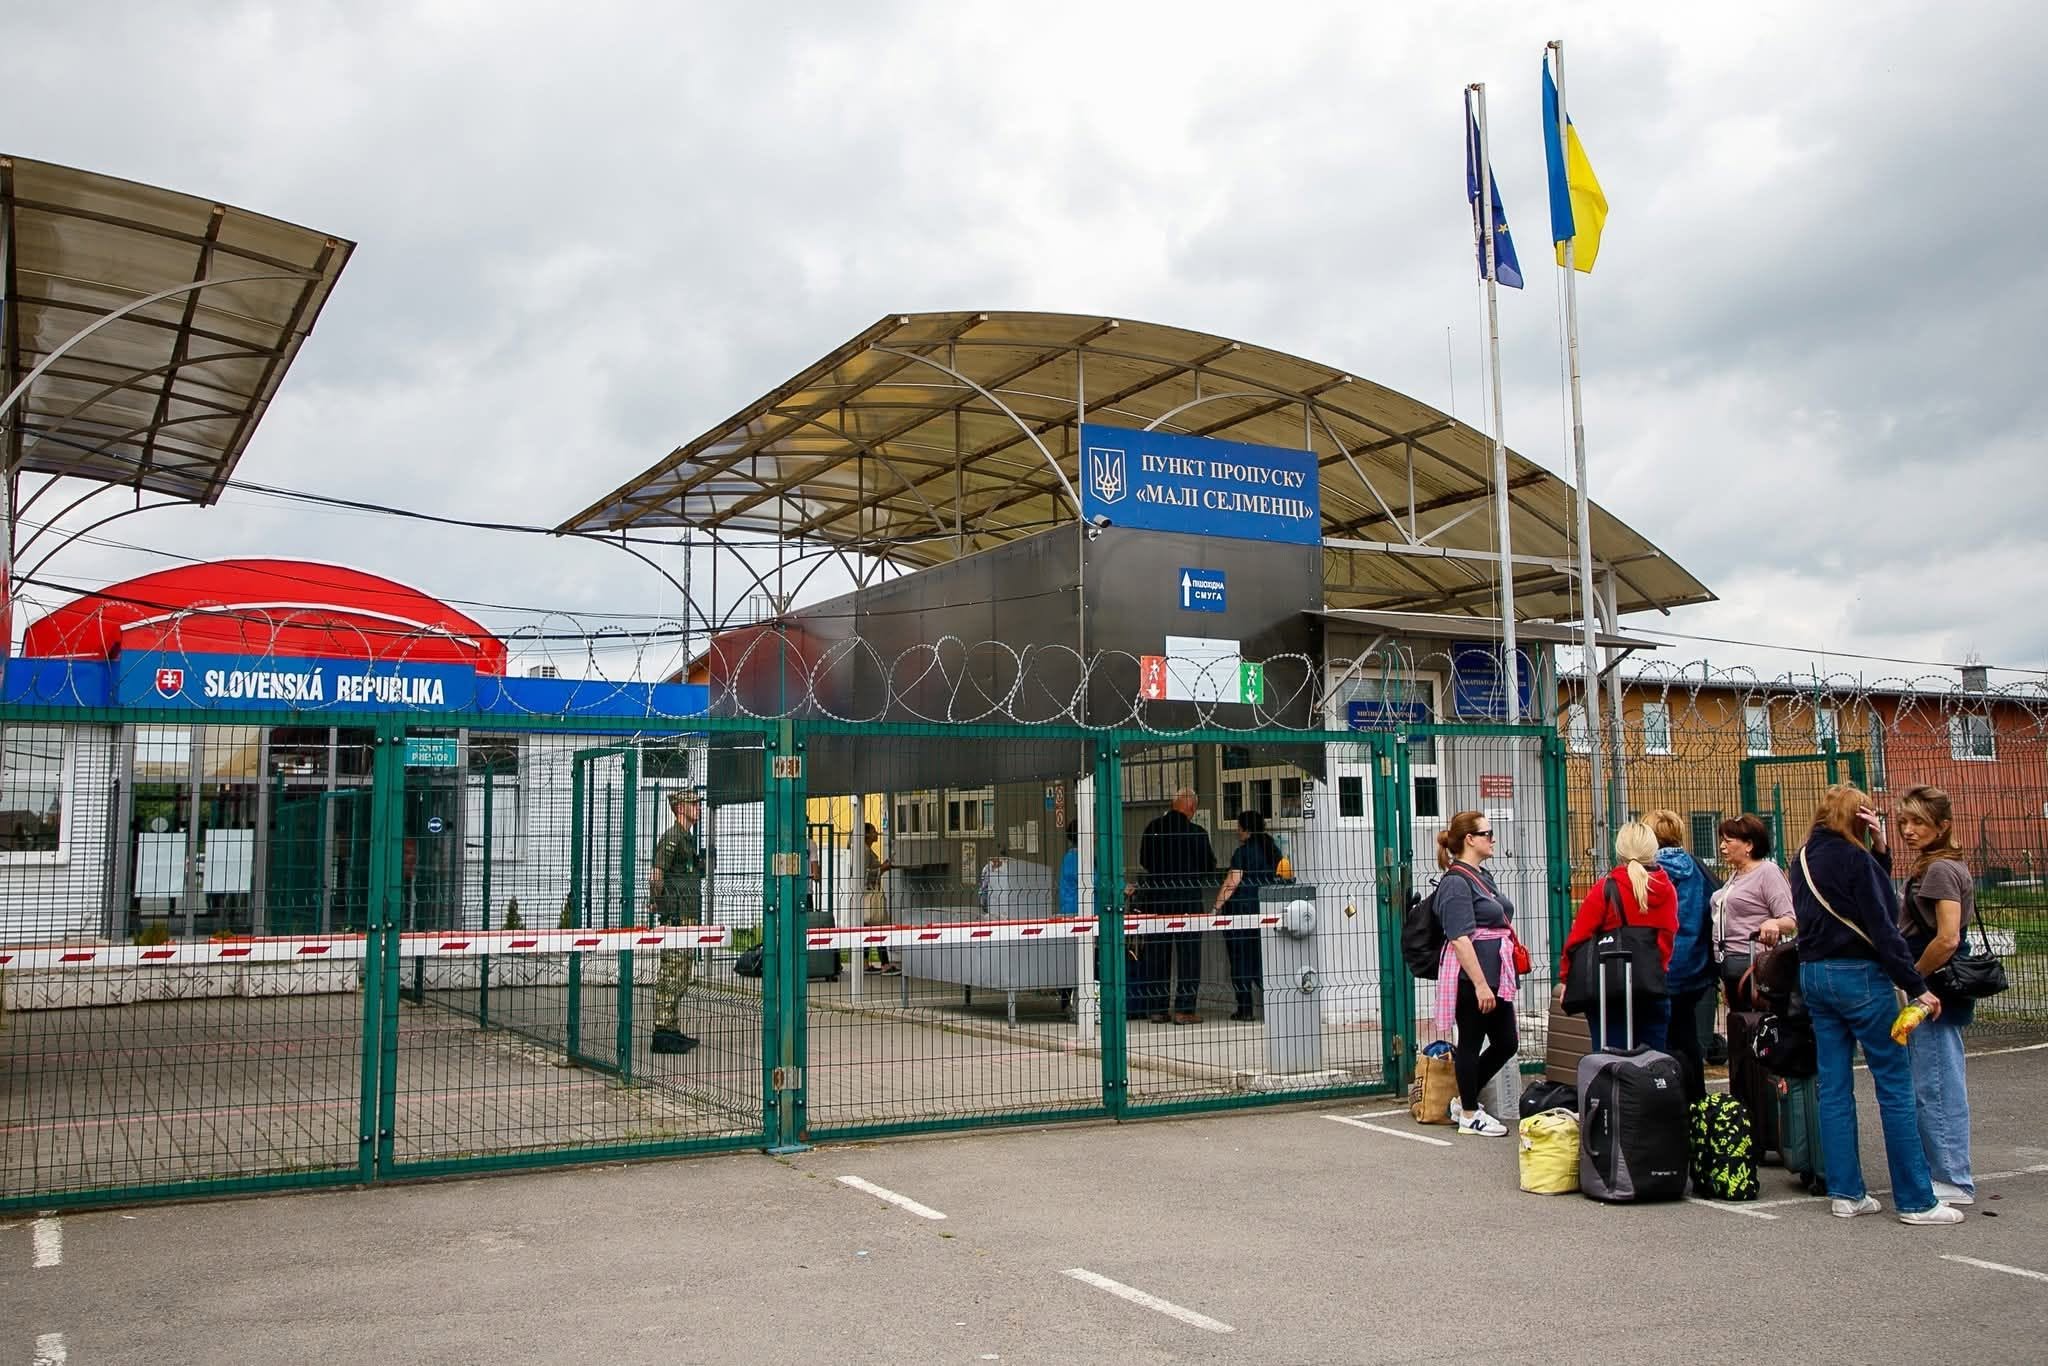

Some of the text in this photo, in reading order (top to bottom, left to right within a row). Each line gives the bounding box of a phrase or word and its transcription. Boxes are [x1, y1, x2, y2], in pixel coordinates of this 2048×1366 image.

[1141, 454, 1306, 488] ПУНКТ ПРОПУСКУ
[1136, 484, 1313, 521] «МАЛІ СЕЛМЕНЦІ»
[1192, 580, 1225, 590] ПІШОХІДНА
[1195, 591, 1222, 601] СМУГА
[203, 667, 444, 704] SLOVENSKÁ REPUBLIKA
